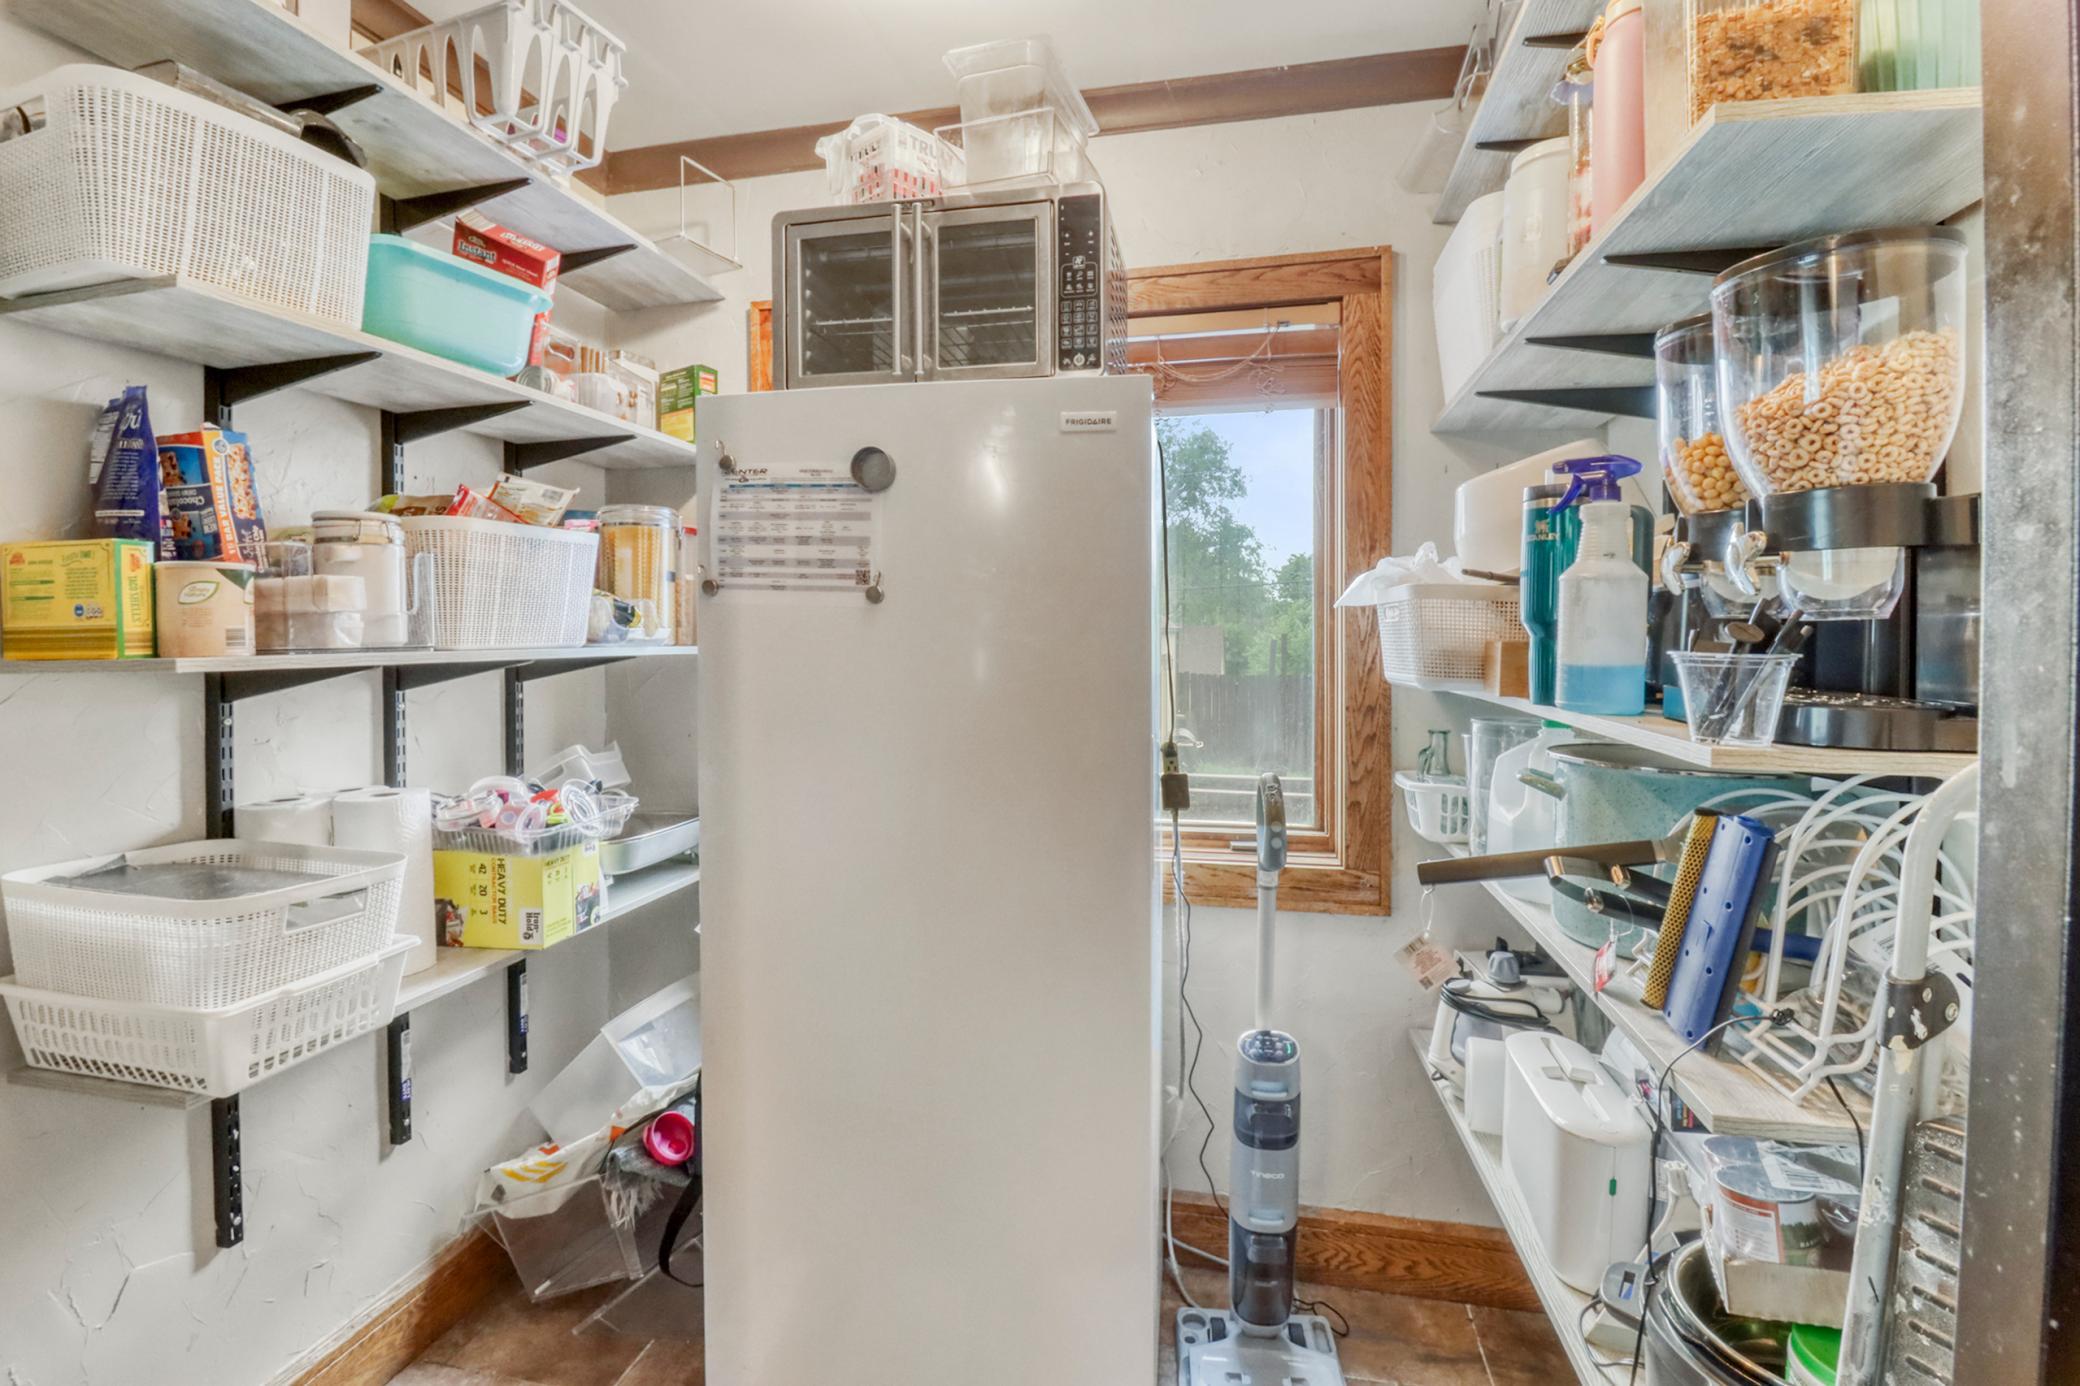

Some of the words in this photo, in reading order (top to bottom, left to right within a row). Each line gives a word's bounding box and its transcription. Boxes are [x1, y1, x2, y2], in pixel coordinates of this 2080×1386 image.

[459, 241, 497, 262] Instant
[1065, 417, 1112, 426] FRIGIDAIRE
[212, 456, 223, 484] PACK
[215, 486, 227, 518] VALUE
[478, 863, 487, 874] 42
[497, 858, 507, 895] HEAVY
[479, 884, 488, 896] 20
[497, 897, 507, 925] DUTY
[526, 912, 534, 932] Hold
